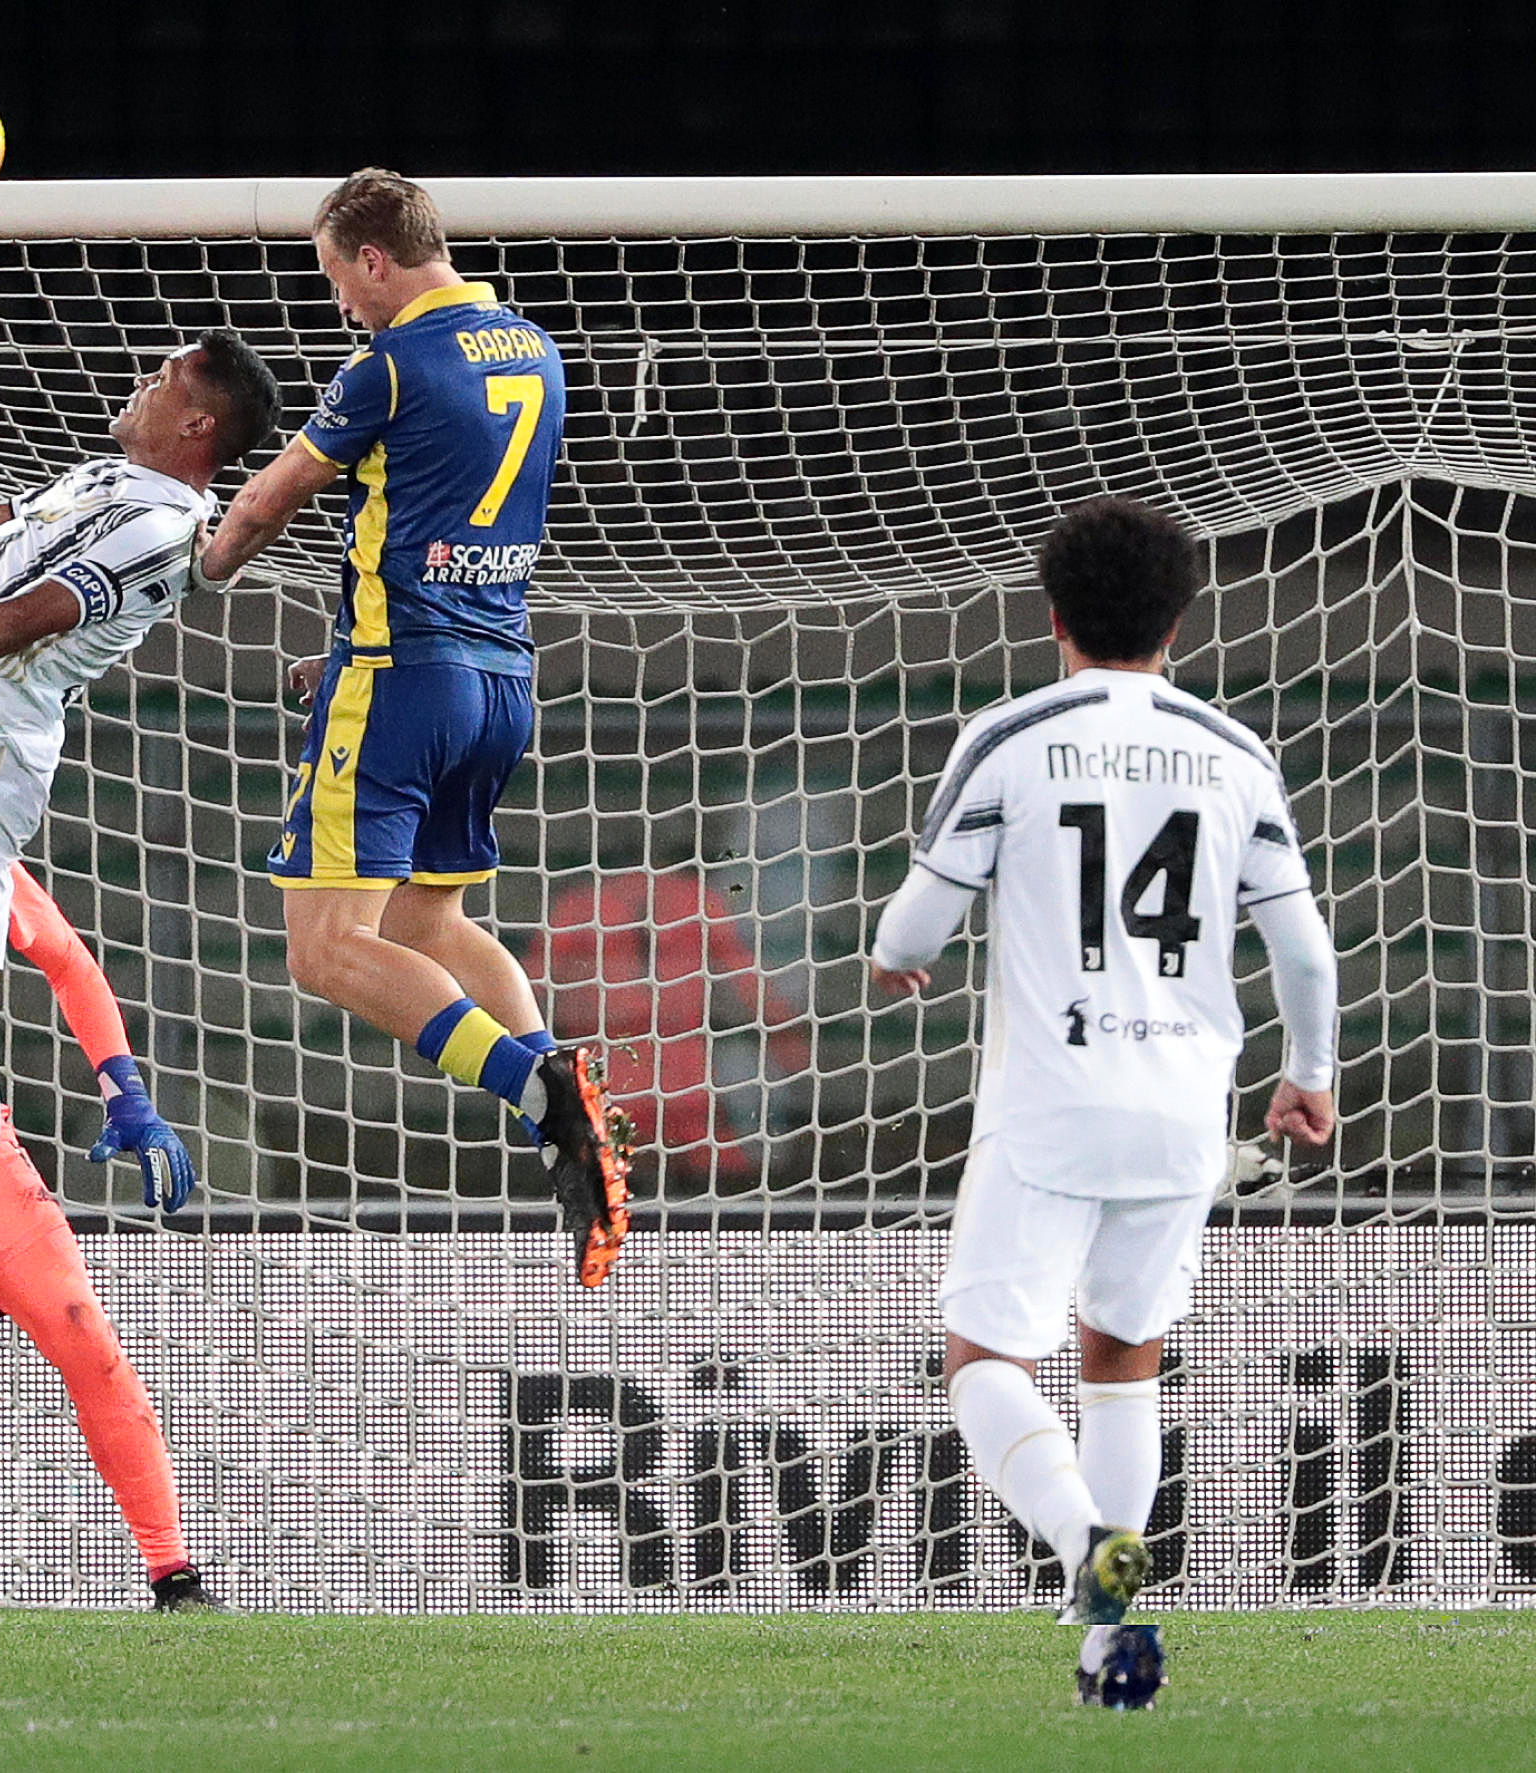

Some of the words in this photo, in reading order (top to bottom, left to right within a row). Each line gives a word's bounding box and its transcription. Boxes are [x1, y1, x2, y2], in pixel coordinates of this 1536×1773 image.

[470, 375, 545, 527] 7
[422, 566, 536, 585] ARREDAMENT
[1059, 802, 1201, 979] 14
[500, 1350, 1193, 1595] Rivii
[1281, 1349, 1411, 1591] il
